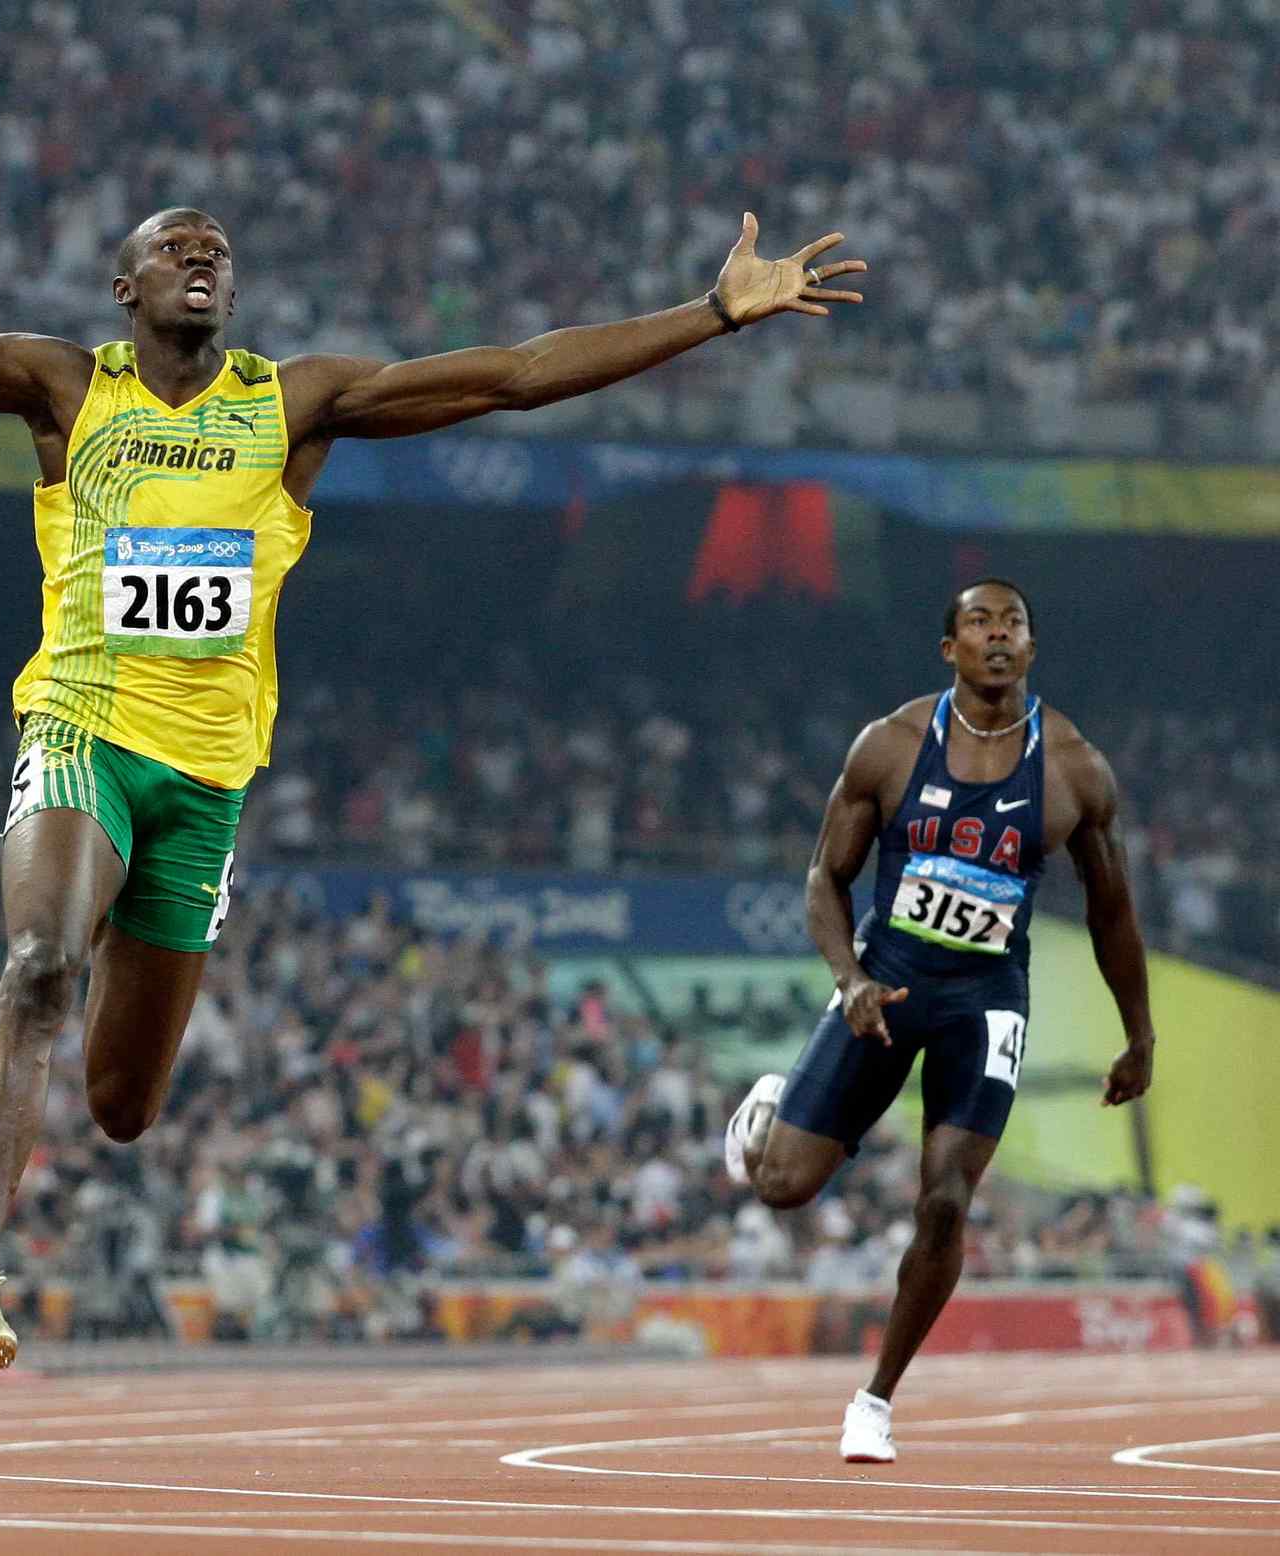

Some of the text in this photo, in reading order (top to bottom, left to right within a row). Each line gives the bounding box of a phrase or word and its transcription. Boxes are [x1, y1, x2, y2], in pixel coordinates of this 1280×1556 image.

[106, 429, 236, 472] jamaica
[120, 574, 232, 632] 2163
[906, 815, 1022, 873] USA
[907, 883, 1000, 943] 3152
[997, 1023, 1019, 1076] 4
